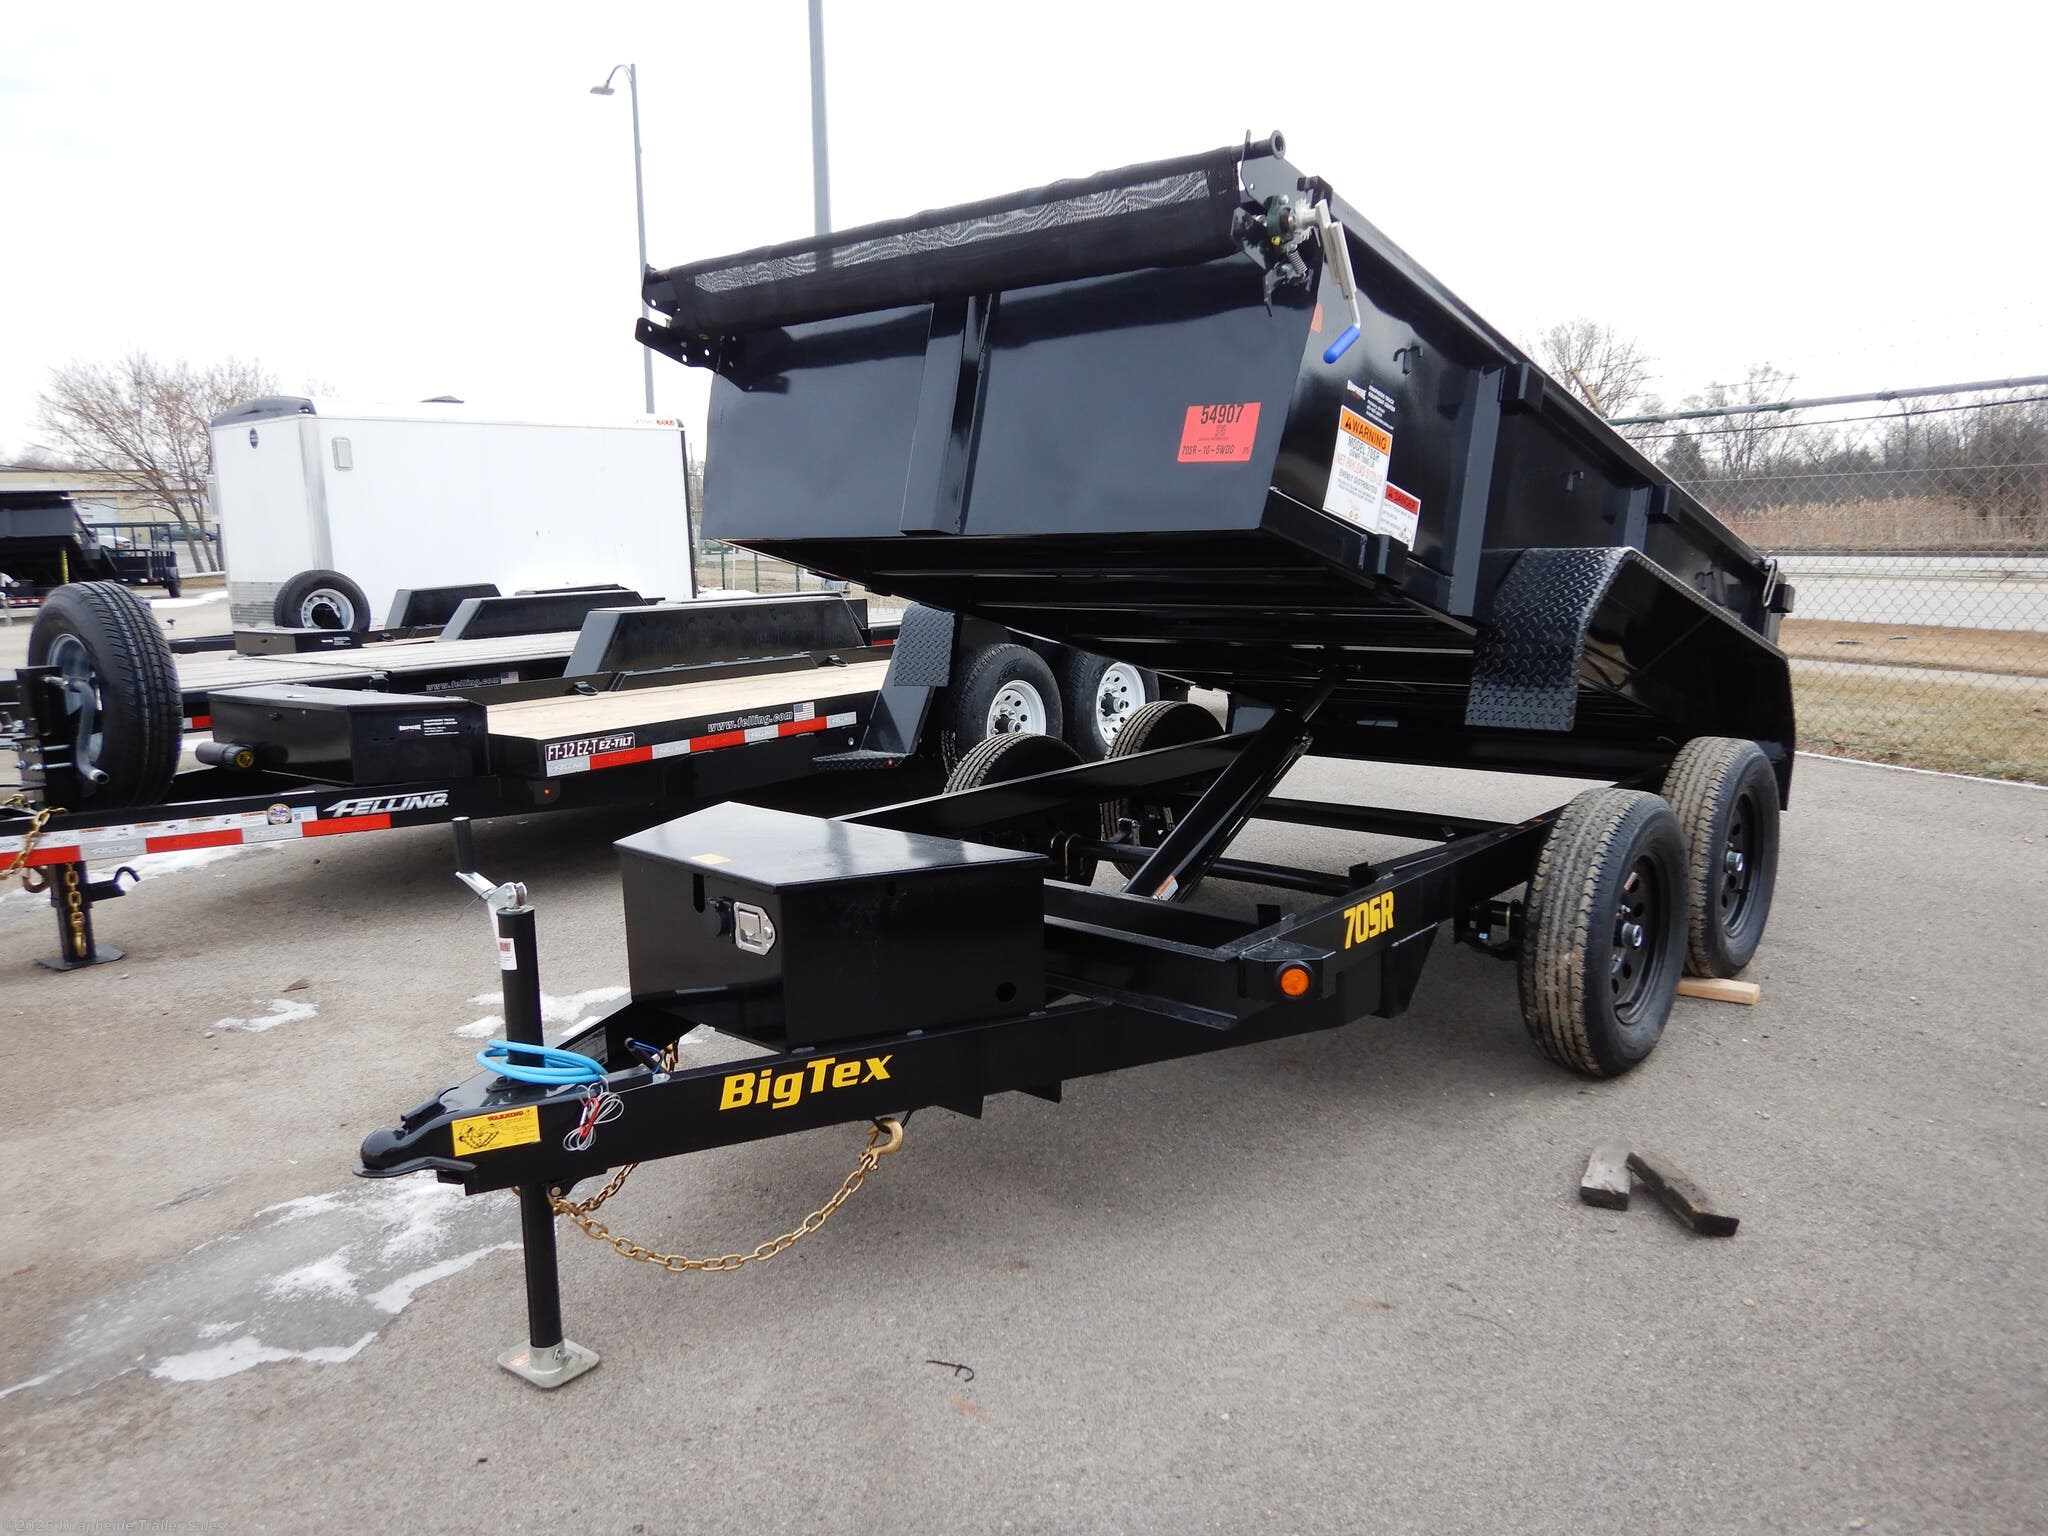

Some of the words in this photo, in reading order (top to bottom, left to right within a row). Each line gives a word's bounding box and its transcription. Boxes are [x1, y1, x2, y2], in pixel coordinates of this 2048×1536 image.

[1201, 405, 1244, 424] 54907
[1350, 420, 1387, 449] WARNING
[707, 711, 794, 733] www.felling.com
[547, 742, 576, 761] FT-12
[576, 739, 598, 756] EZ-T
[598, 736, 633, 751] EZ-TILT
[322, 790, 449, 818] FELLING
[1343, 890, 1395, 949] 70SR
